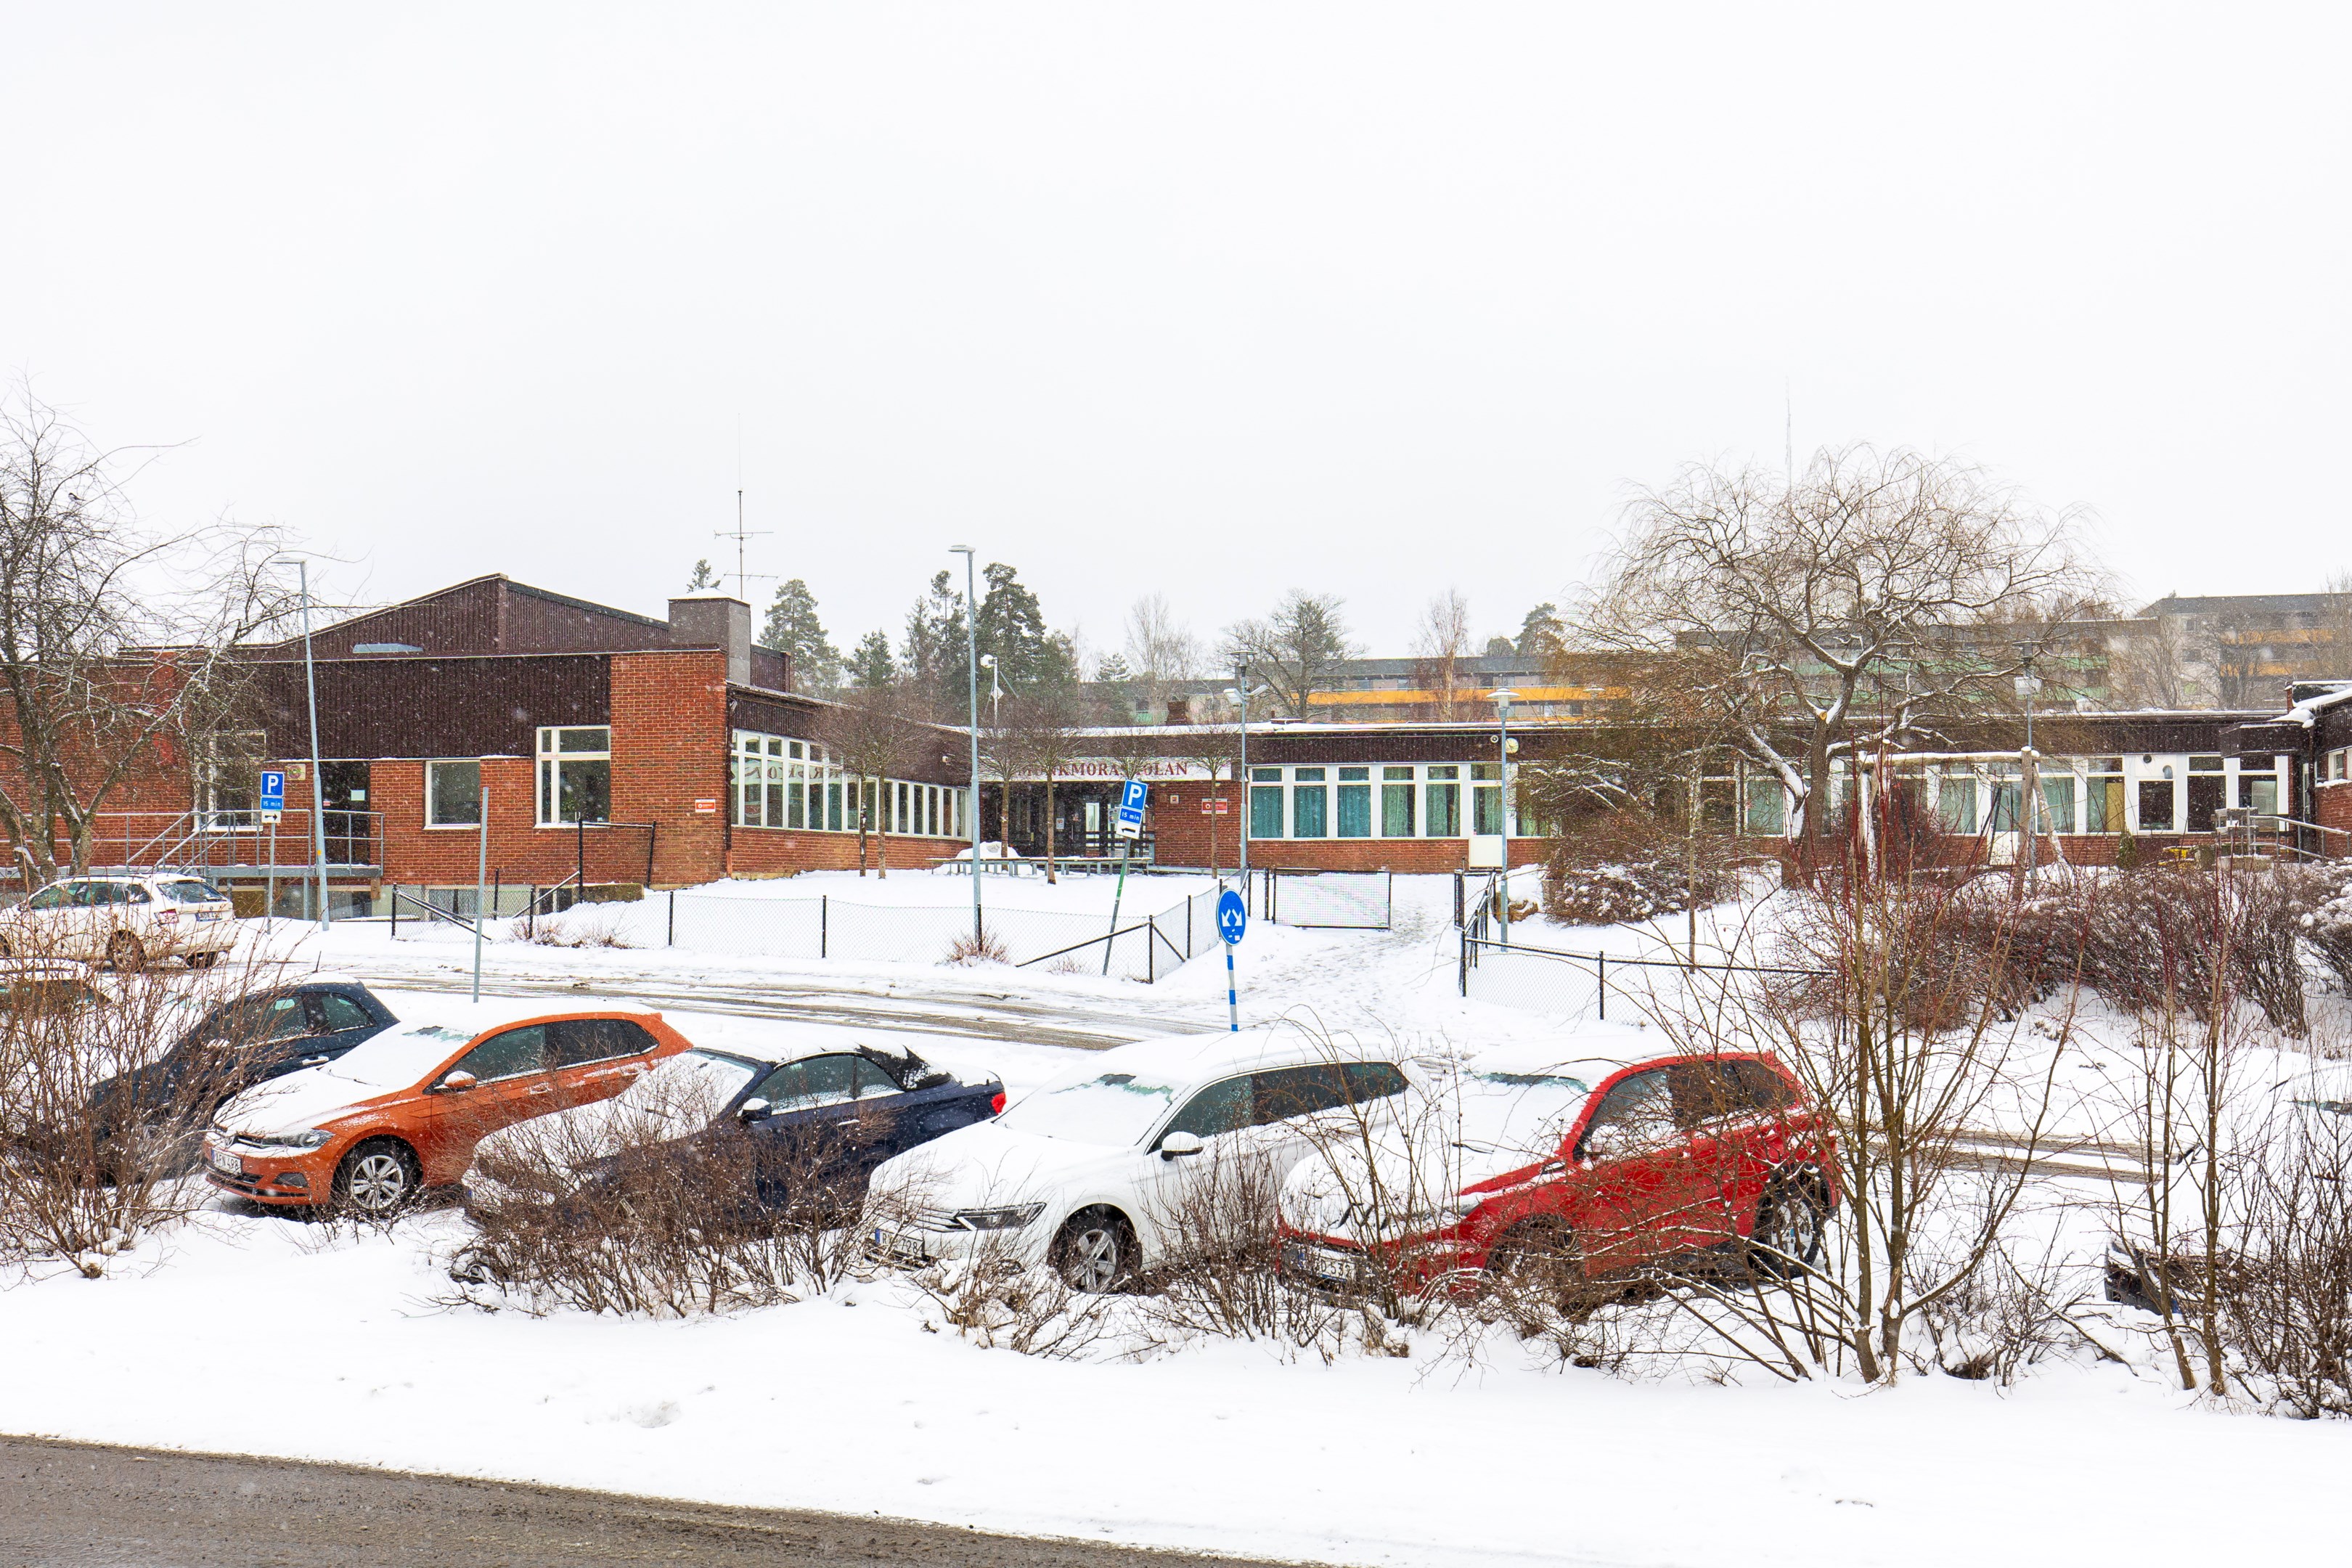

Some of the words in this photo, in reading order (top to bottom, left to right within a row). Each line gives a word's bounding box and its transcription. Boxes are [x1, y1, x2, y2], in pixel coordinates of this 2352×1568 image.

[267, 775, 279, 794] P
[1127, 783, 1143, 806] P
[901, 1238, 918, 1255] 728
